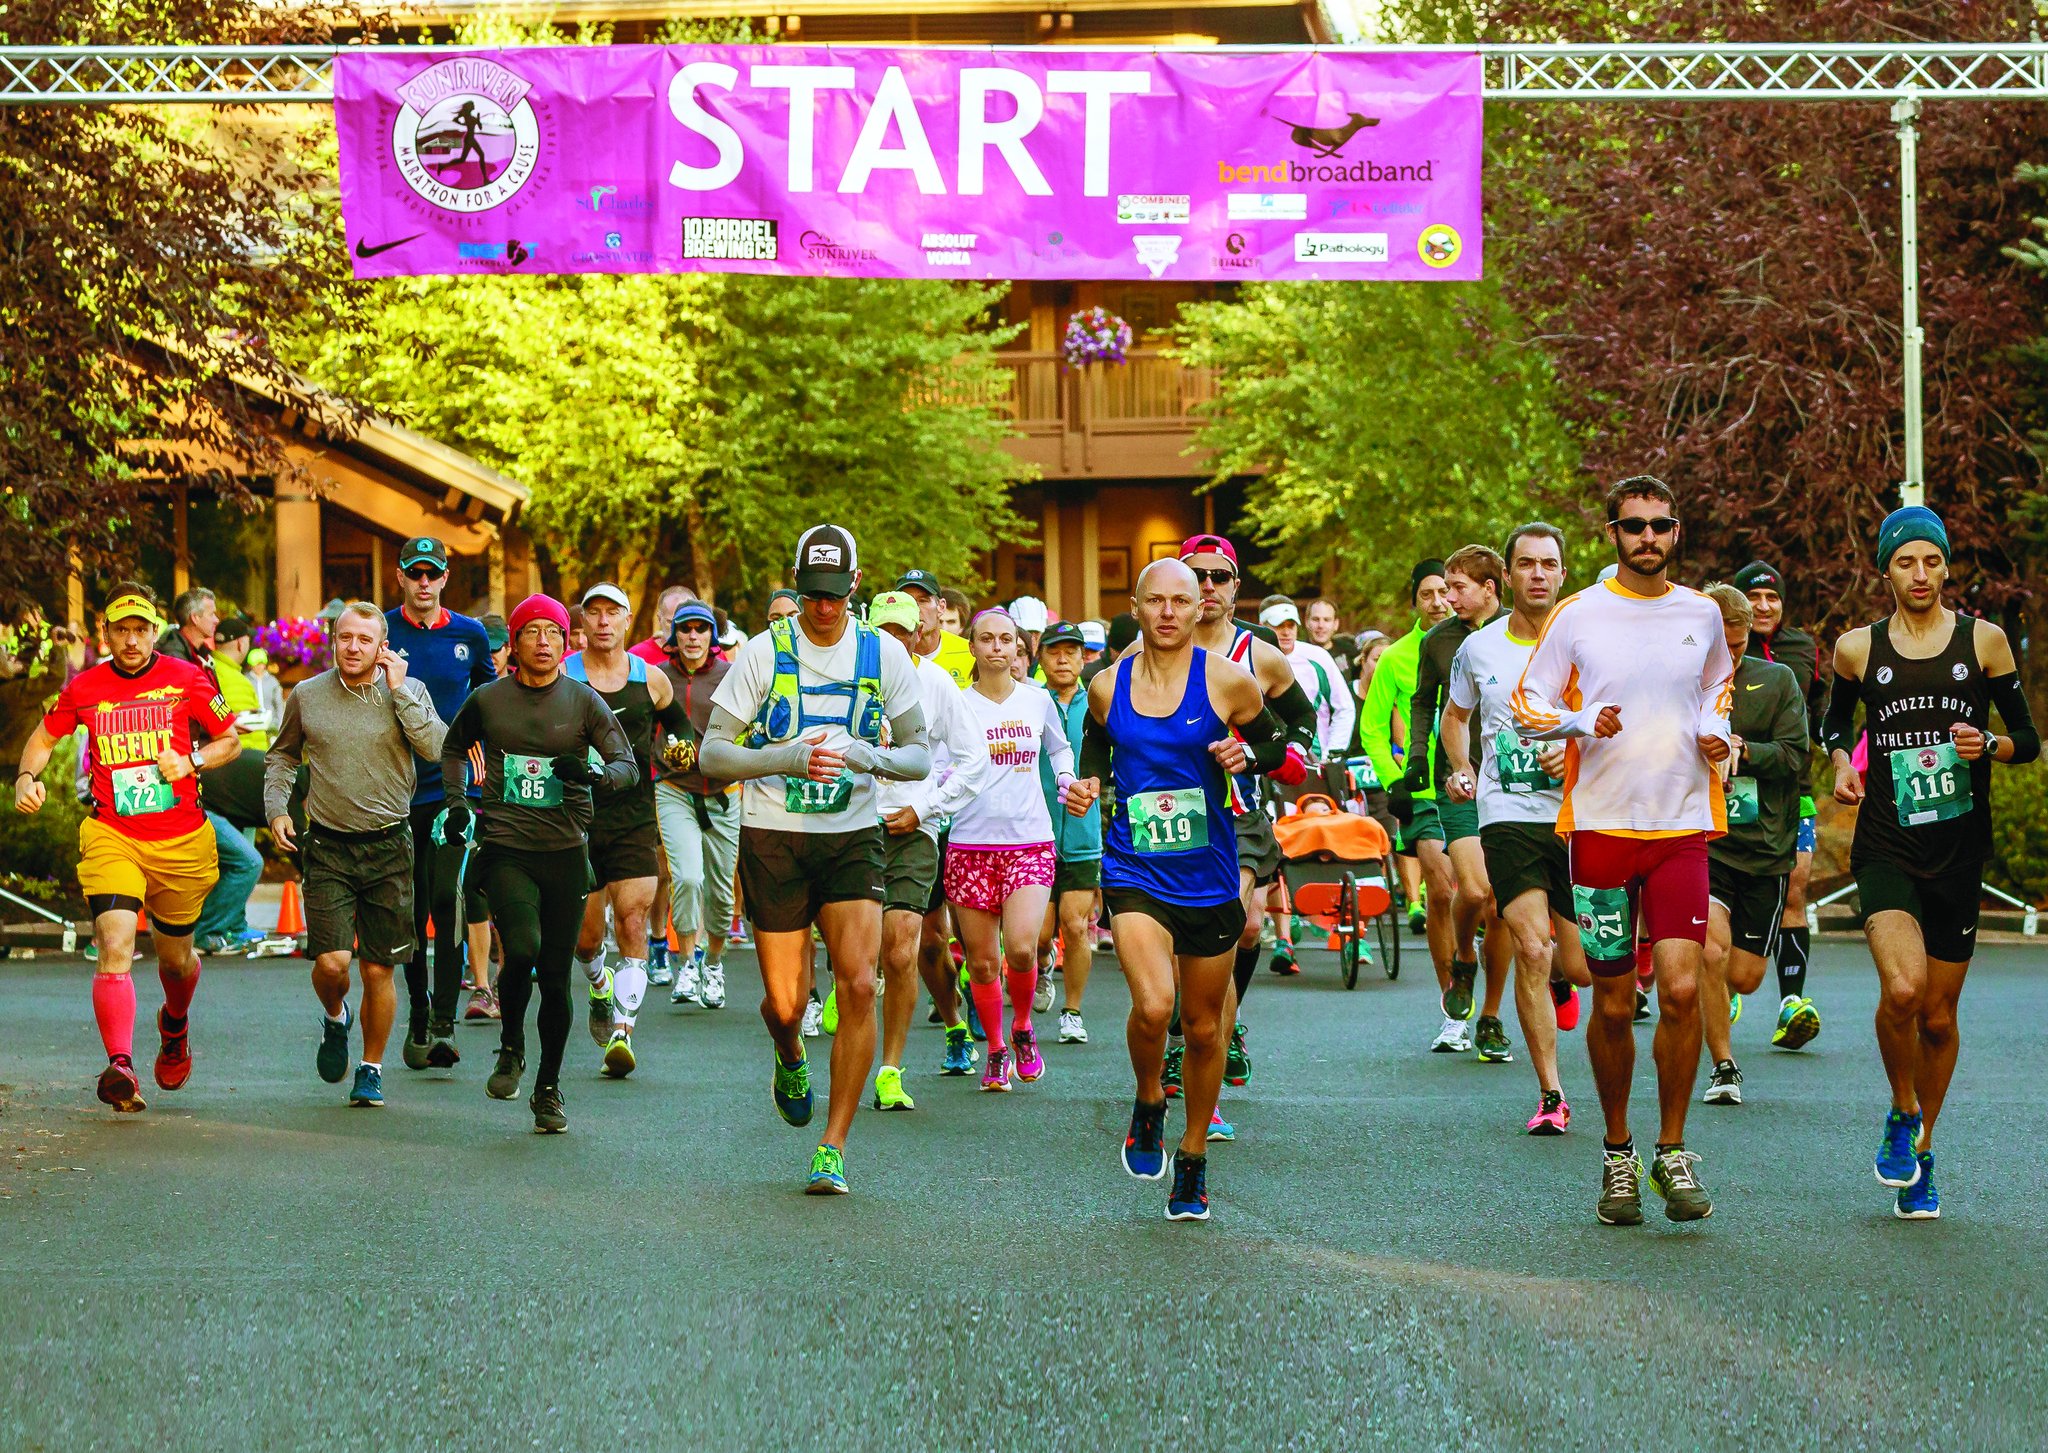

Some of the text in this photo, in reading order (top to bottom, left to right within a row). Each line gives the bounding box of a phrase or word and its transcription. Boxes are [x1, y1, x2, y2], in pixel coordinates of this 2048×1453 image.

[408, 60, 522, 111] SUNRIVER
[668, 61, 1151, 197] START
[400, 144, 535, 208] MARATHON FOR A CAUSE
[1131, 195, 1189, 205] COMBINED
[921, 233, 978, 249] ABSOLUT
[1320, 243, 1384, 256] Pathology
[808, 248, 880, 260] SUNRIVER
[926, 250, 972, 266] VODKA
[1879, 696, 1973, 722] JACUZZI BOYS
[95, 705, 174, 737] DOUBLE
[1001, 719, 1024, 730] start
[986, 726, 1033, 741] strong
[1875, 731, 1941, 747] ATHLETIC
[96, 729, 174, 766] AGENT
[988, 740, 1018, 755] nish
[990, 750, 1037, 766] ronger
[1510, 752, 1544, 774] 12
[520, 779, 545, 800] 85
[800, 782, 841, 805] 117
[1910, 771, 1956, 801] 116
[132, 786, 158, 809] 72
[1147, 817, 1192, 844] 119
[1597, 910, 1624, 939] 21
